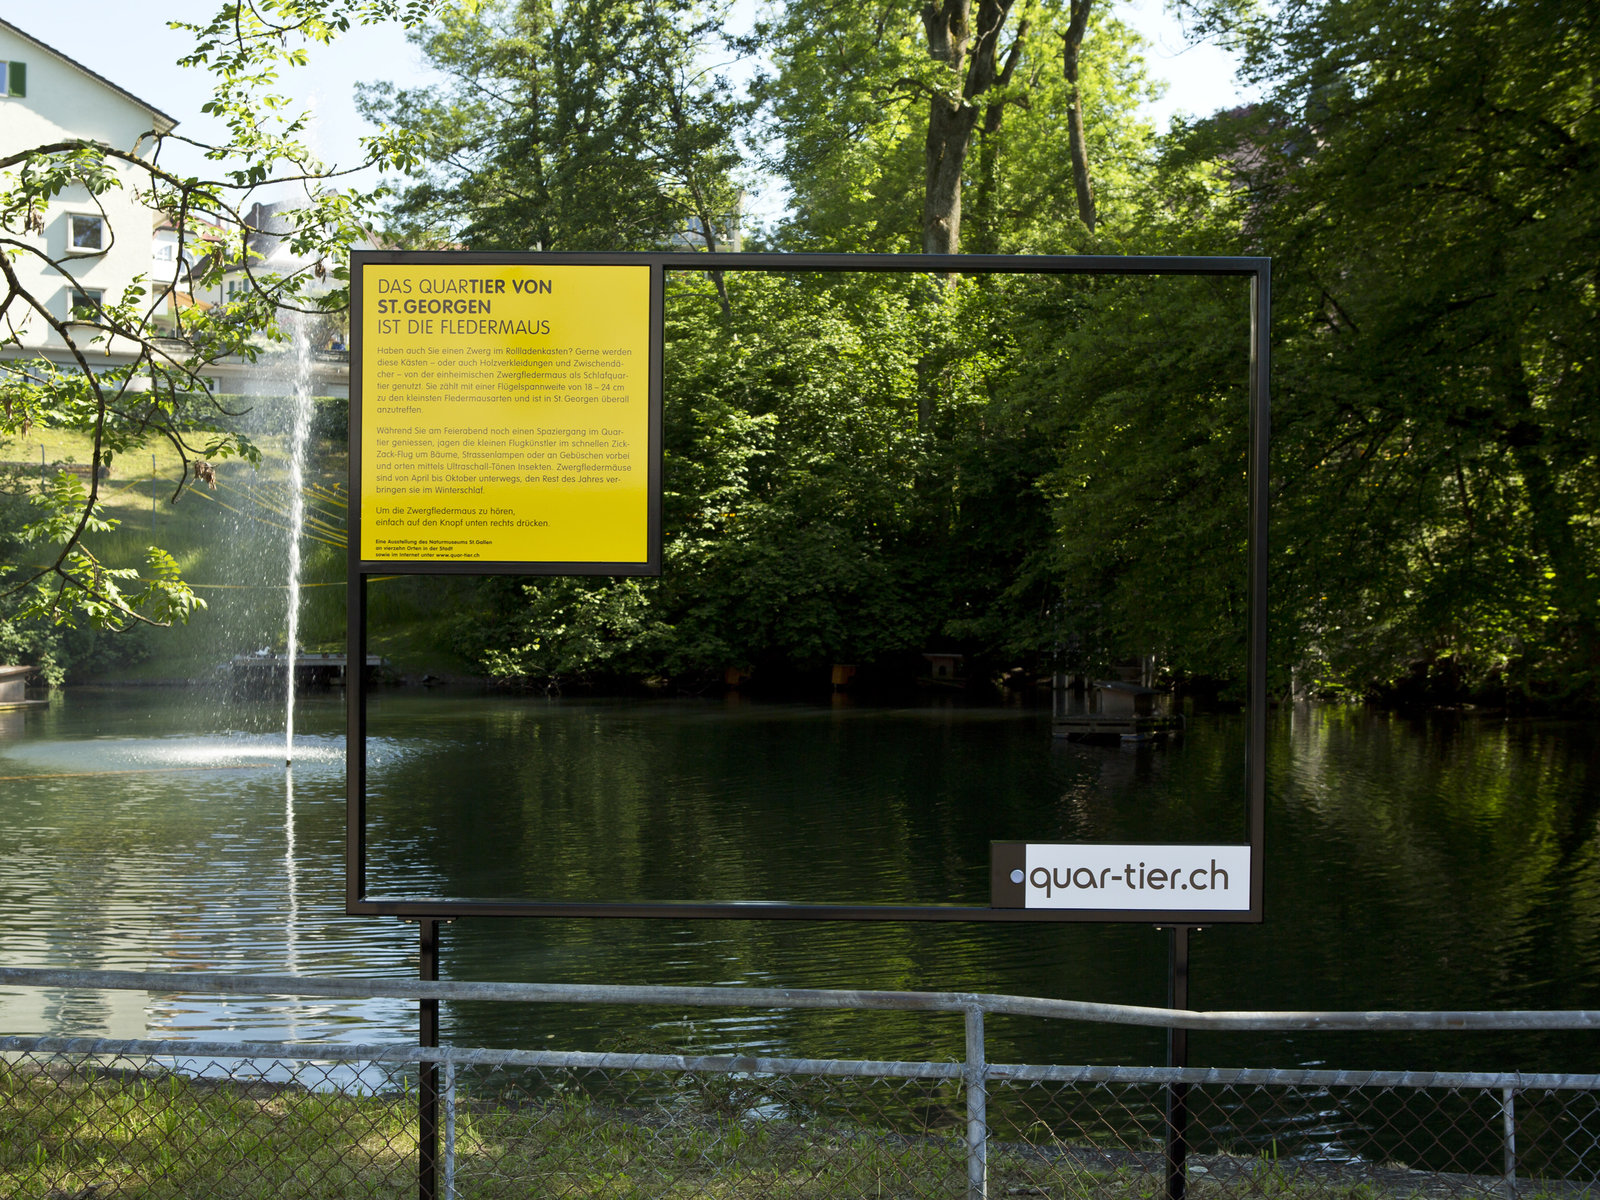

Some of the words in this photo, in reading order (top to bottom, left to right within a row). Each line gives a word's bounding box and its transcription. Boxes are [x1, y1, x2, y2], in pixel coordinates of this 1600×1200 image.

[378, 278, 412, 294] DAS
[419, 278, 505, 295] QUARTIER
[512, 279, 552, 294] VON
[378, 320, 401, 334] IST
[408, 320, 433, 334] DIE
[441, 320, 550, 335] FLEDERMAUS
[466, 347, 491, 356] Zwerg
[480, 359, 552, 368] Holzverkleidungen
[497, 371, 567, 380] Zwergfledermaus
[583, 372, 629, 380] Schlafquar-
[498, 383, 565, 392] Flügelspannweite
[536, 428, 586, 437] Spaziergang
[392, 439, 434, 448] geniessen,
[437, 439, 460, 448] jagen
[508, 439, 556, 449] Flugkünstler
[376, 451, 413, 460] Zack-Flug
[556, 463, 632, 472] Zwergfledermäuse
[411, 474, 429, 484] April
[479, 475, 522, 484] unterwegs,
[376, 486, 406, 495] bringen
[407, 507, 476, 516] Zwergfledermaus
[490, 508, 515, 516] hören,
[440, 519, 463, 528] Knopf
[1030, 859, 1229, 898] quar-tier.ch
